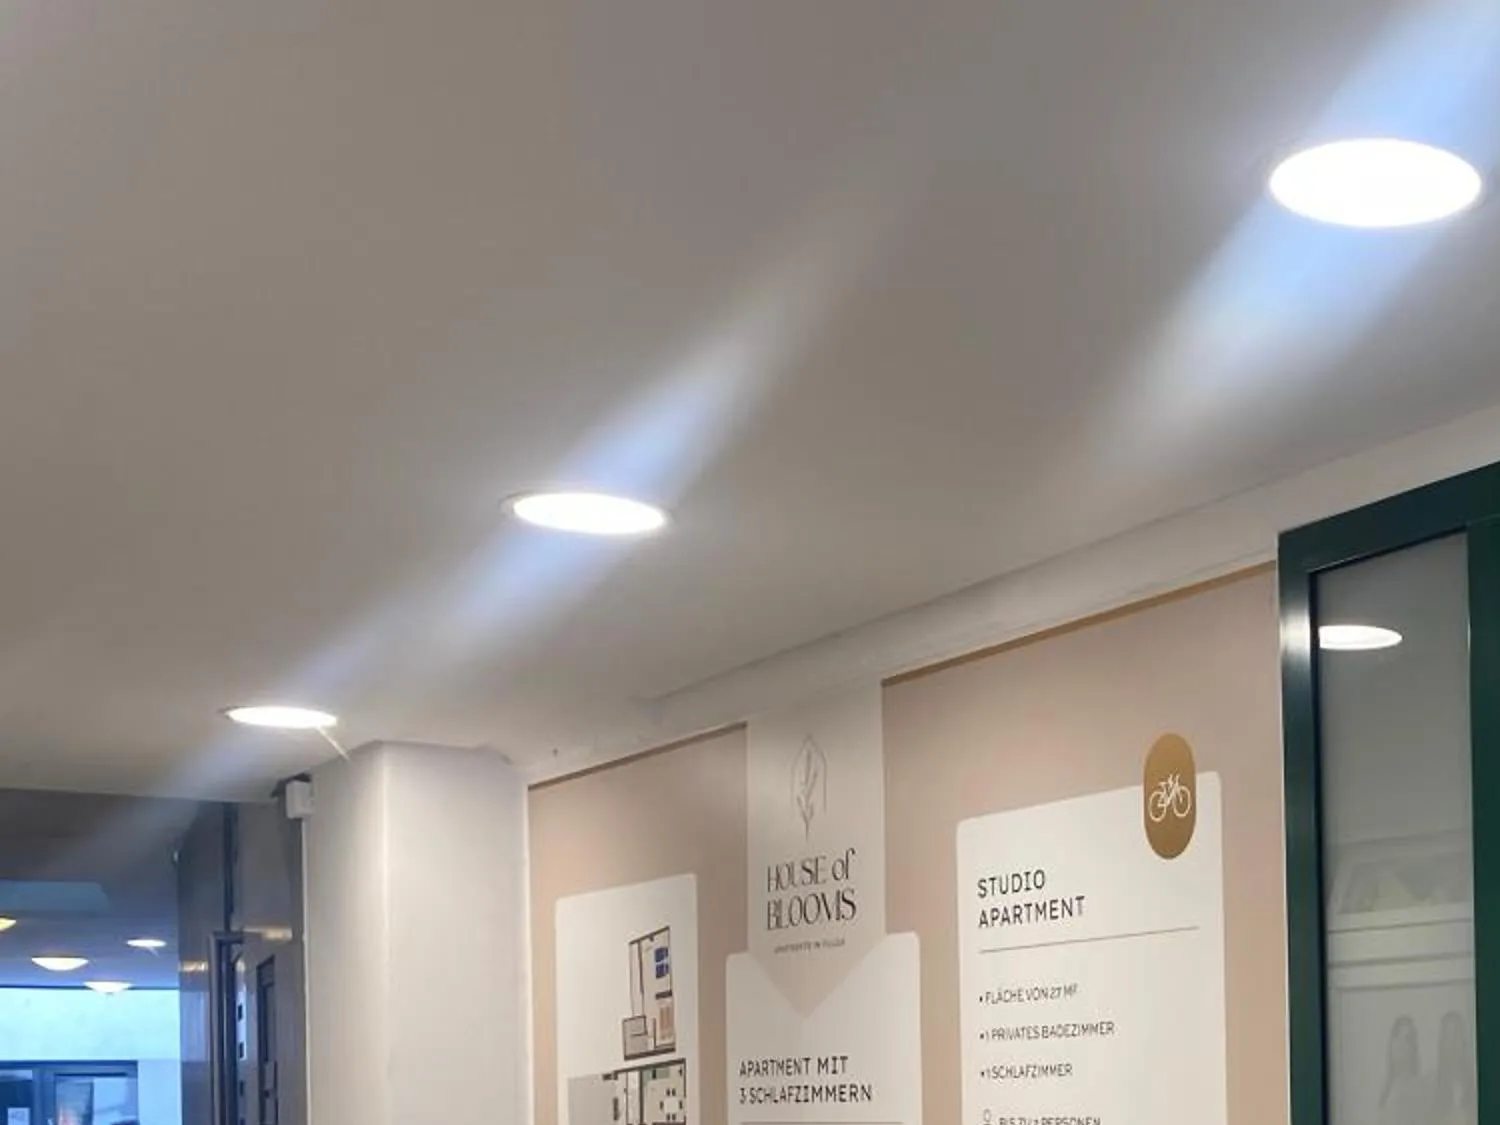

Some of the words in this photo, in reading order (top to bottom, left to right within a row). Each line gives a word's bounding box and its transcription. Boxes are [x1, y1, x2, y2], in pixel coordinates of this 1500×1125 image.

[767, 855, 827, 893] HOUSE
[831, 847, 856, 882] of
[977, 869, 1046, 899] STUDIO
[766, 886, 857, 931] BLOOMS
[979, 895, 1085, 928] APARTMENT
[1025, 986, 1048, 1001] VON
[991, 1025, 1040, 1041] PRIVATES
[1041, 1020, 1115, 1039] BADEZIMMER
[739, 1056, 811, 1076] APARTMENT
[816, 1055, 849, 1075] MIT
[991, 1063, 1073, 1079] SCHLAFZIMMER
[749, 1083, 873, 1105] SCHLAFZIMMERN
